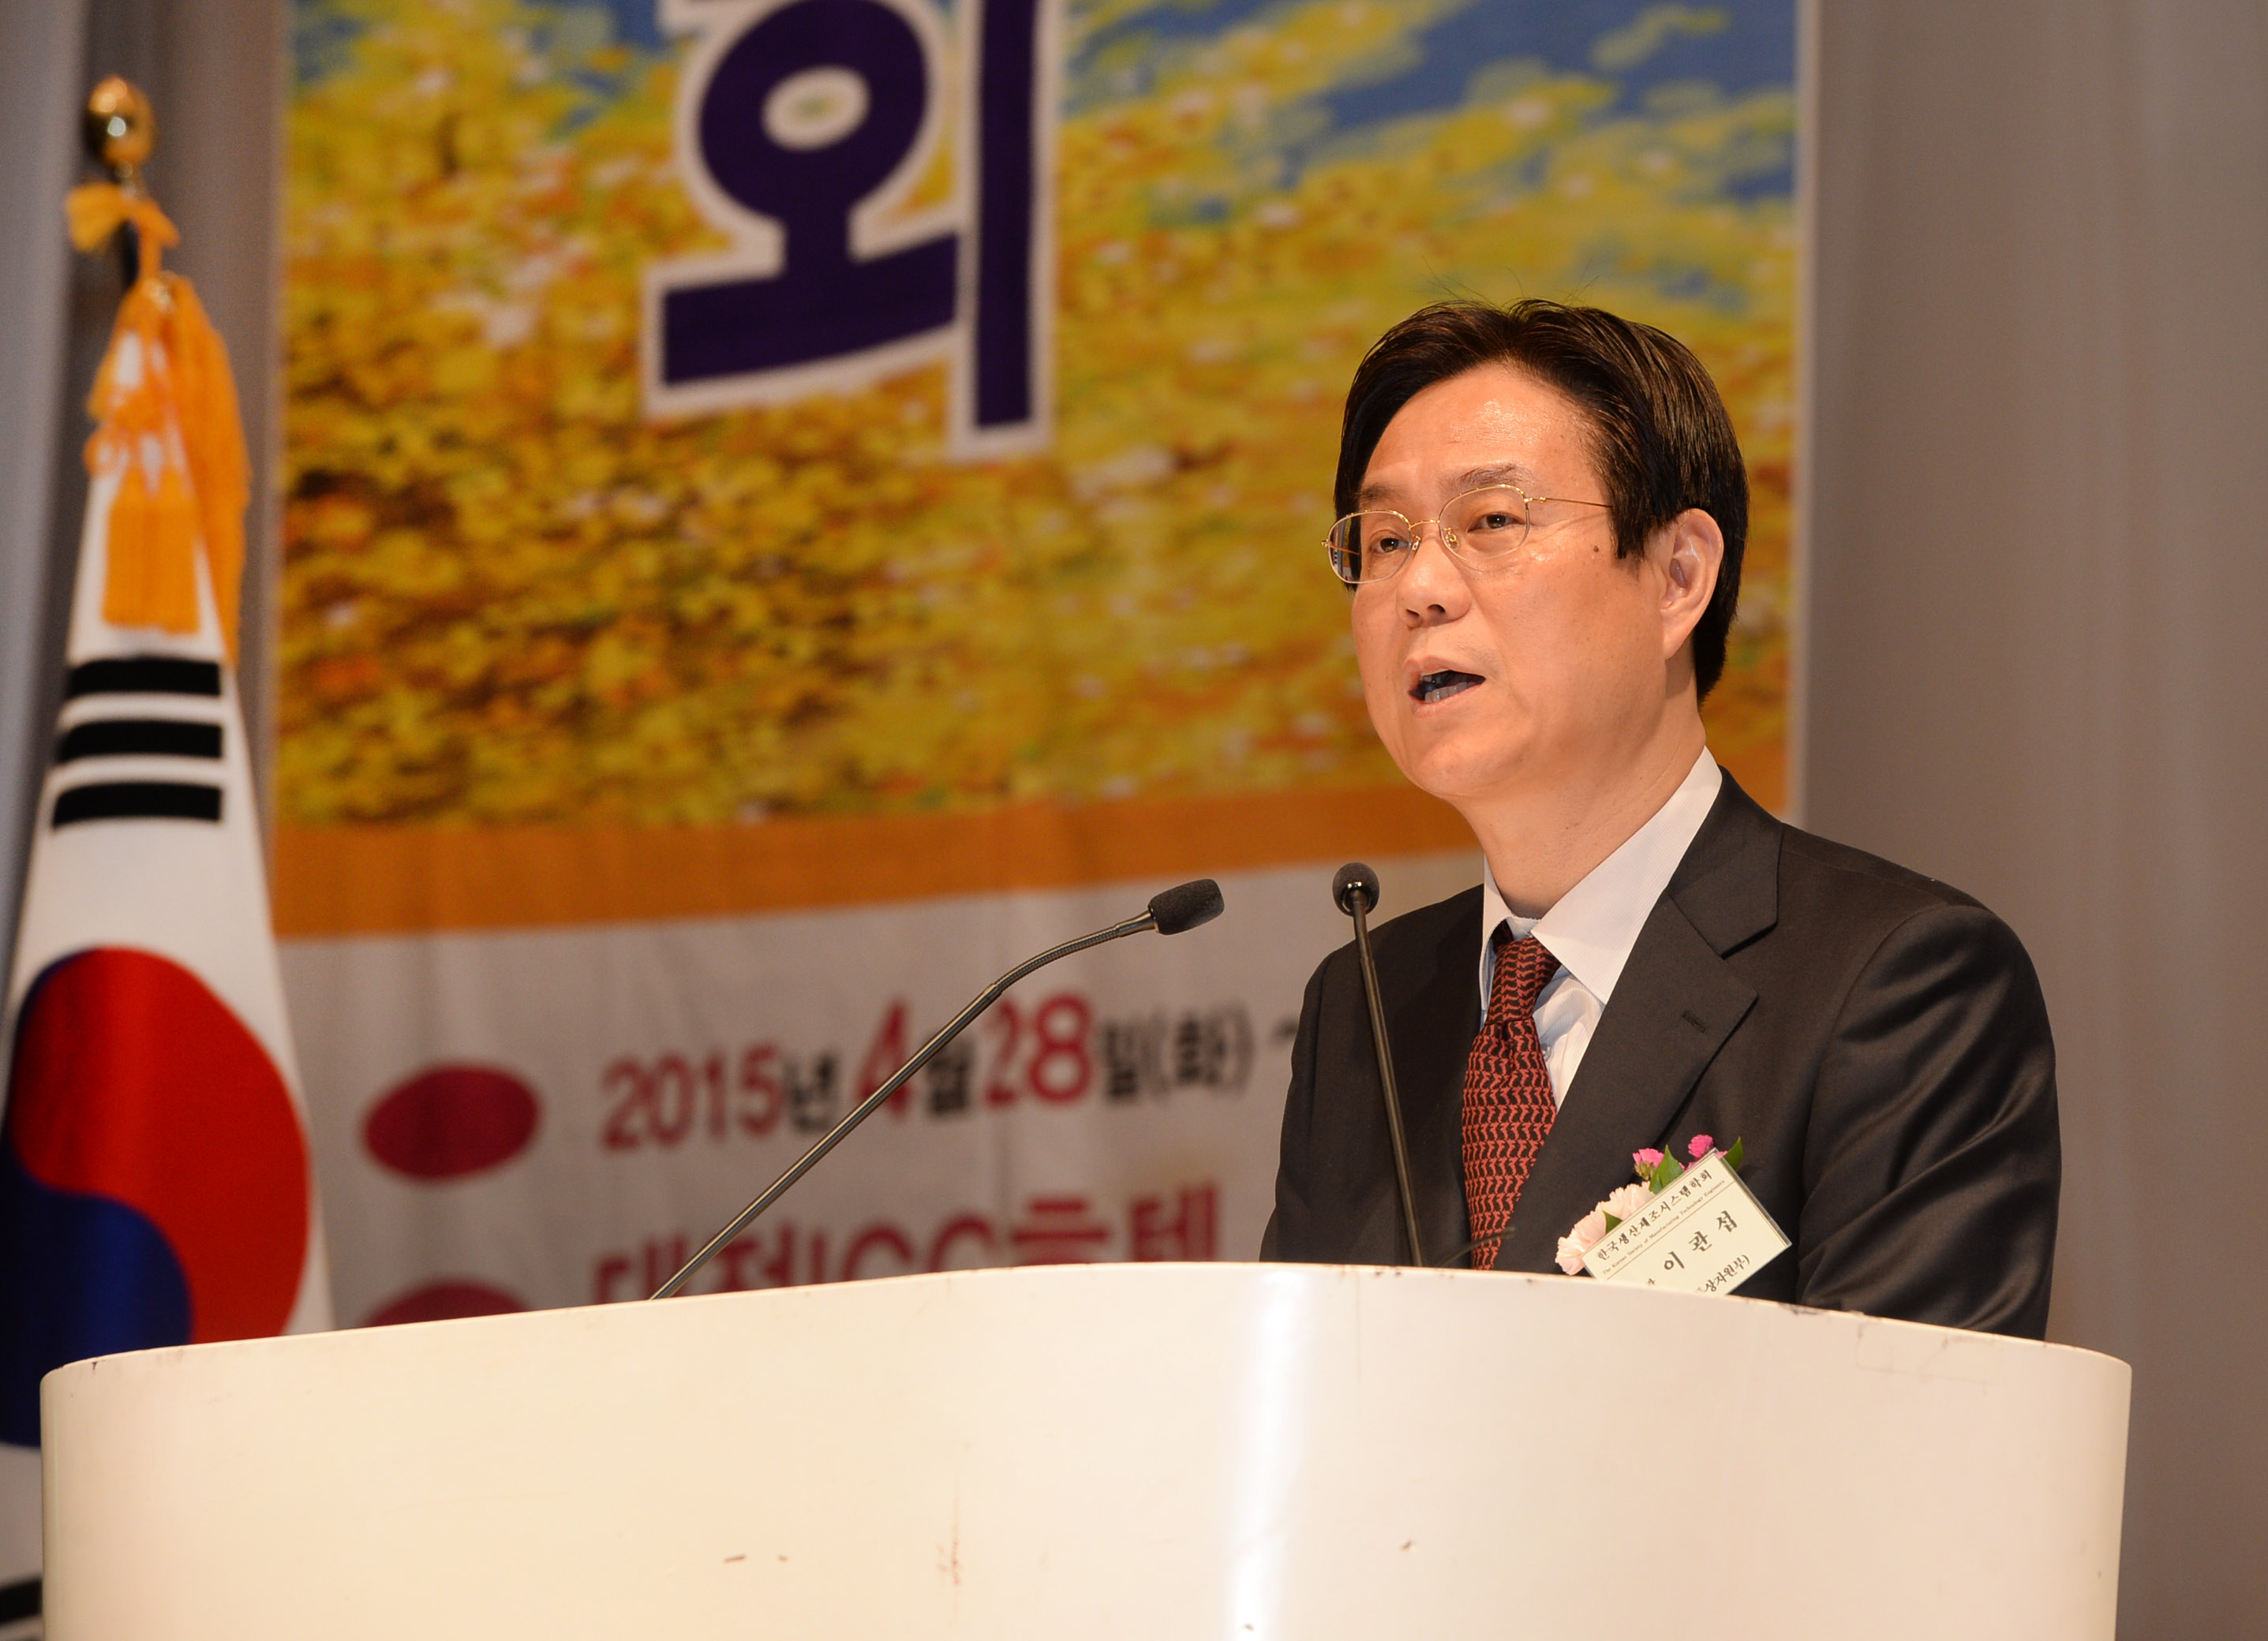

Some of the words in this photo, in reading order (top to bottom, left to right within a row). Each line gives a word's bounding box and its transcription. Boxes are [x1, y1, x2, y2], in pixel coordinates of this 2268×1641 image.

[1627, 1244, 1643, 1256] Society
[1649, 1215, 1680, 1239] Manufacturing
[1679, 1197, 1704, 1216] Technology
[1696, 1254, 1750, 1292] 상자원부)
